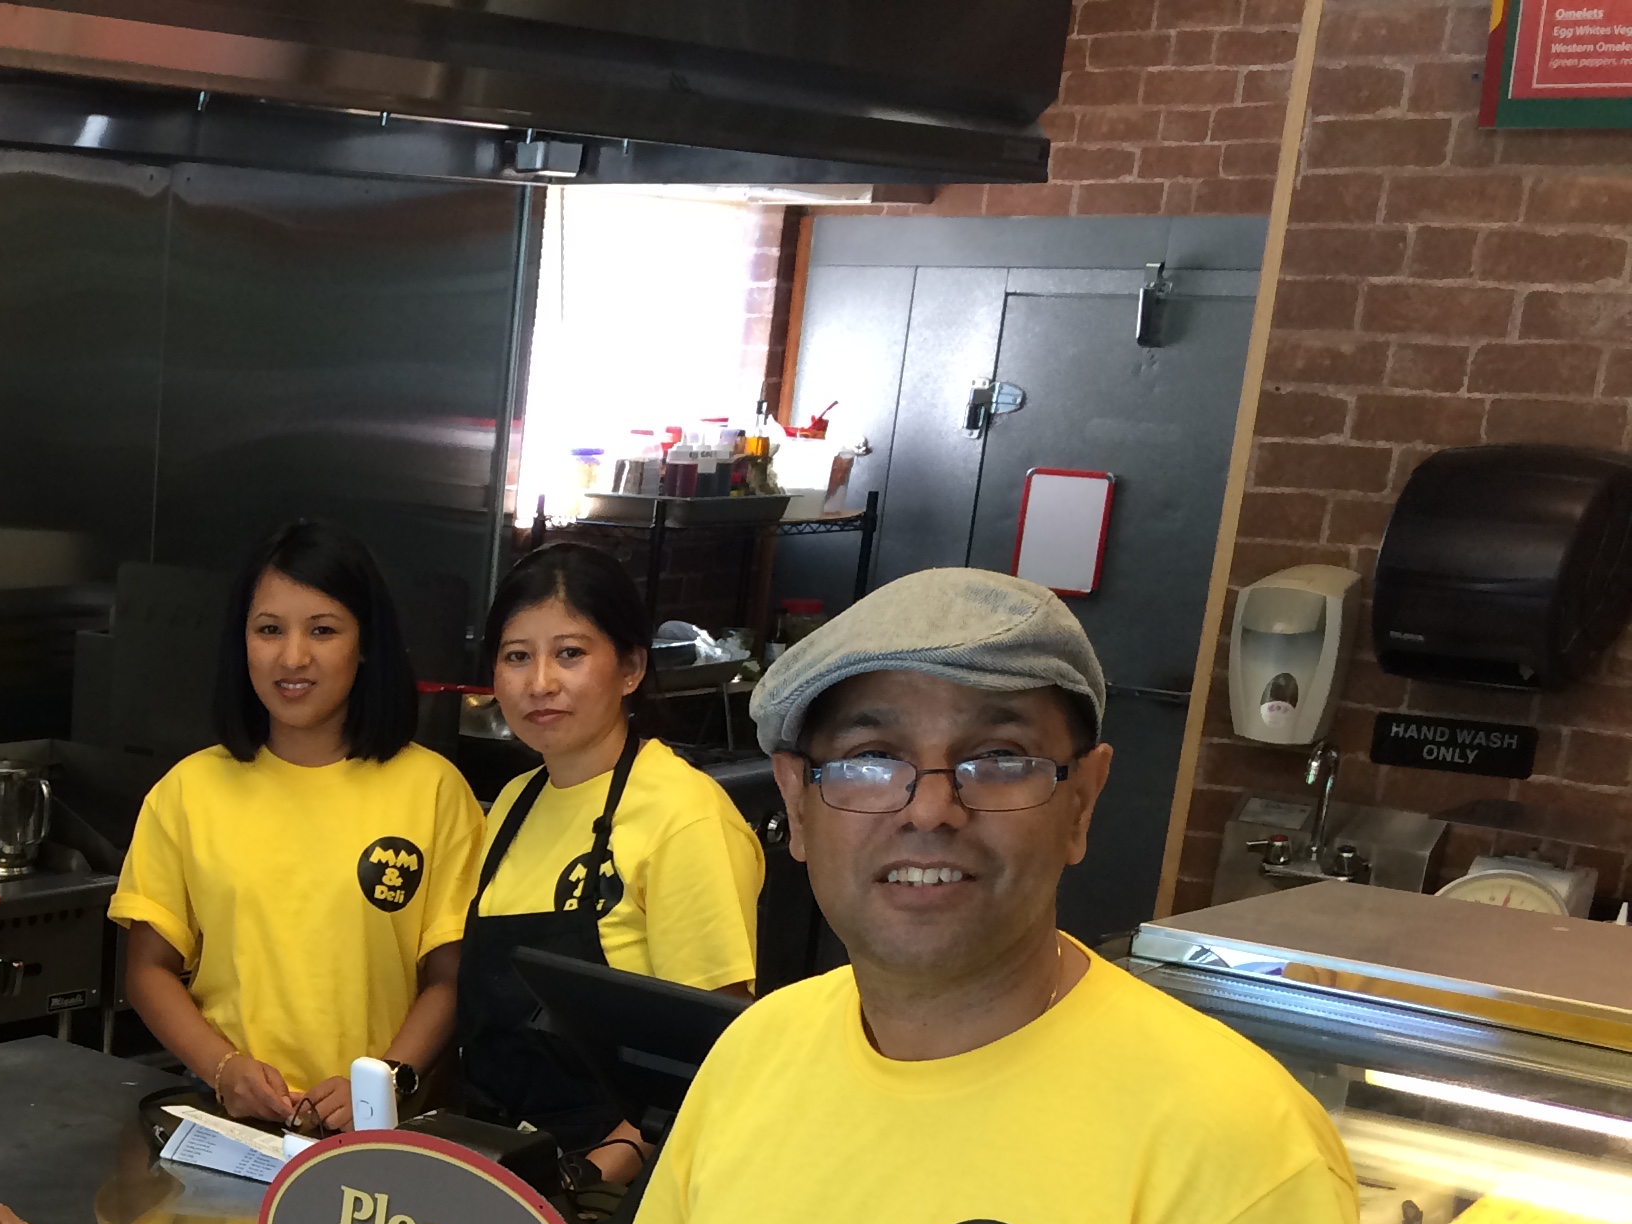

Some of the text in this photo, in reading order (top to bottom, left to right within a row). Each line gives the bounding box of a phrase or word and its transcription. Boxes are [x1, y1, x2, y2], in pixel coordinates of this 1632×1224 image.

[1555, 8, 1604, 20] Omelets
[1553, 26, 1574, 38] Egg
[1575, 25, 1611, 36] Whites
[1551, 43, 1594, 53] Western
[1390, 722, 1519, 749] HAND WASH
[1422, 744, 1479, 765] ONLY
[369, 845, 418, 871] MM
[381, 867, 404, 887] &
[373, 884, 406, 903] Deli
